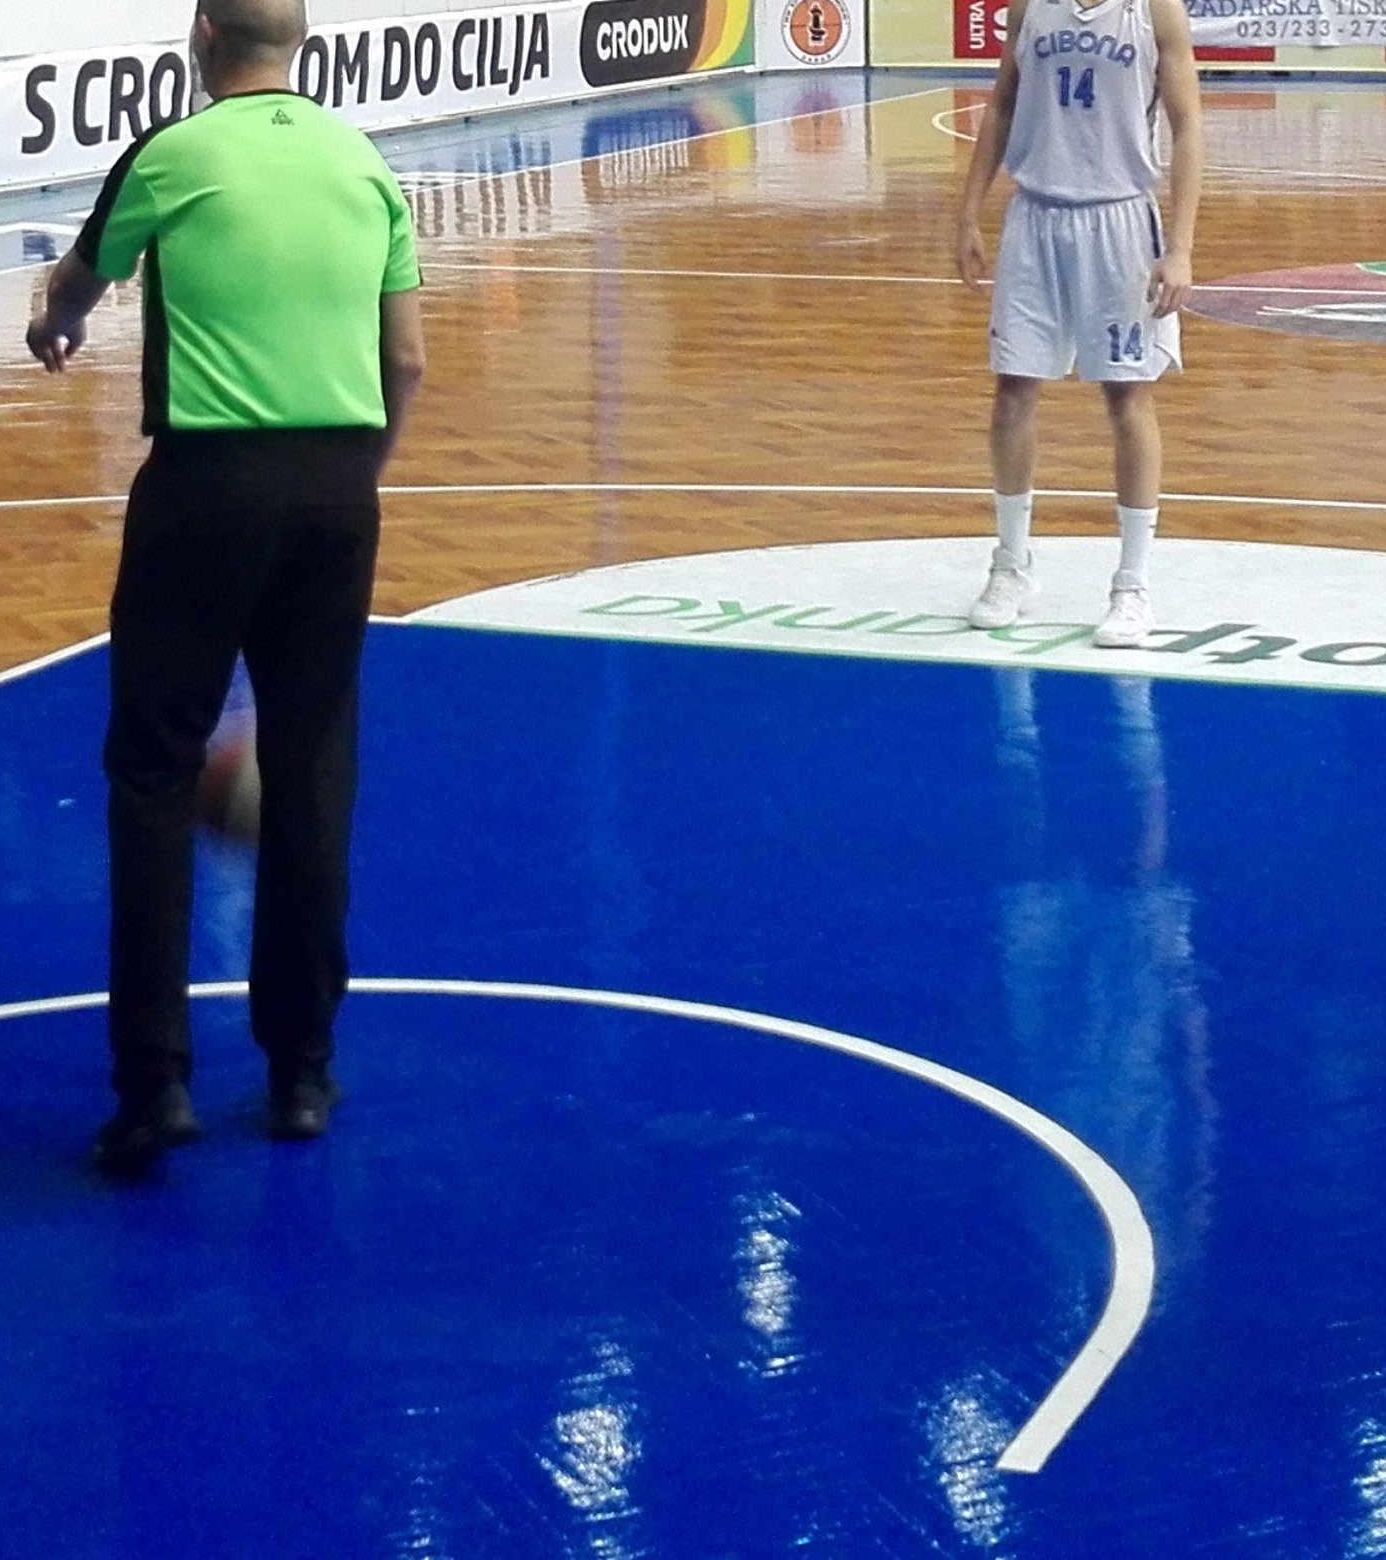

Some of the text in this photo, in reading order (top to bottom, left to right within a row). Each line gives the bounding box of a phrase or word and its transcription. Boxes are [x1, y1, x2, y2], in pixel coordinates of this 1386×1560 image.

[596, 13, 690, 61] CRODUX
[968, 0, 986, 50] ULTRA
[1034, 29, 1137, 69] CIBONA
[20, 63, 58, 155] S
[380, 21, 442, 101] DO
[451, 11, 551, 96] CILJA
[1056, 65, 1096, 109] 14
[1106, 321, 1144, 364] 14
